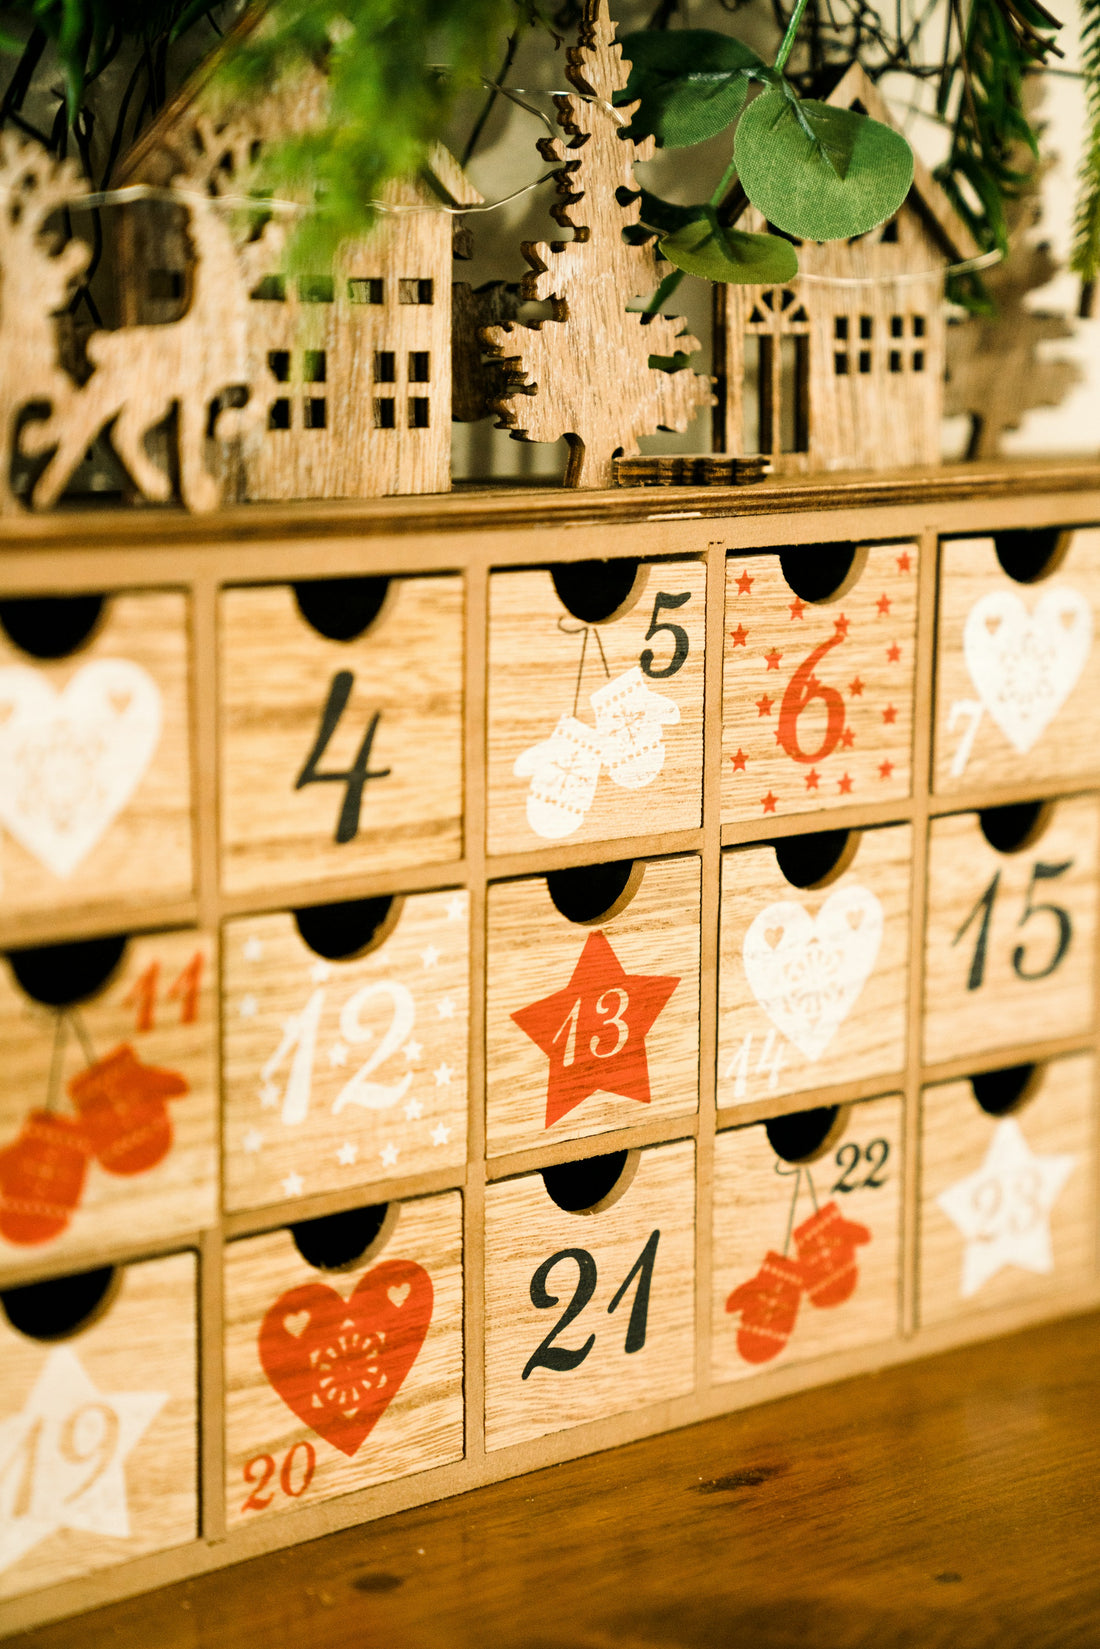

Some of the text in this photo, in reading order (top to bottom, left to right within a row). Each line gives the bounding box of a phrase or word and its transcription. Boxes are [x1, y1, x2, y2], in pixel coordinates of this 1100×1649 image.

[641, 592, 691, 678] 5
[779, 634, 846, 763] 6
[946, 700, 985, 776] 7
[294, 670, 391, 843] 4
[952, 860, 1074, 991] 15
[122, 952, 204, 1033] 11
[552, 988, 629, 1067] 13
[261, 980, 415, 1124] 12
[725, 1030, 788, 1097] 14
[830, 1139, 890, 1193] 22
[522, 1229, 660, 1380] 21
[0, 1402, 119, 1520] 19
[241, 1441, 316, 1512] 20
